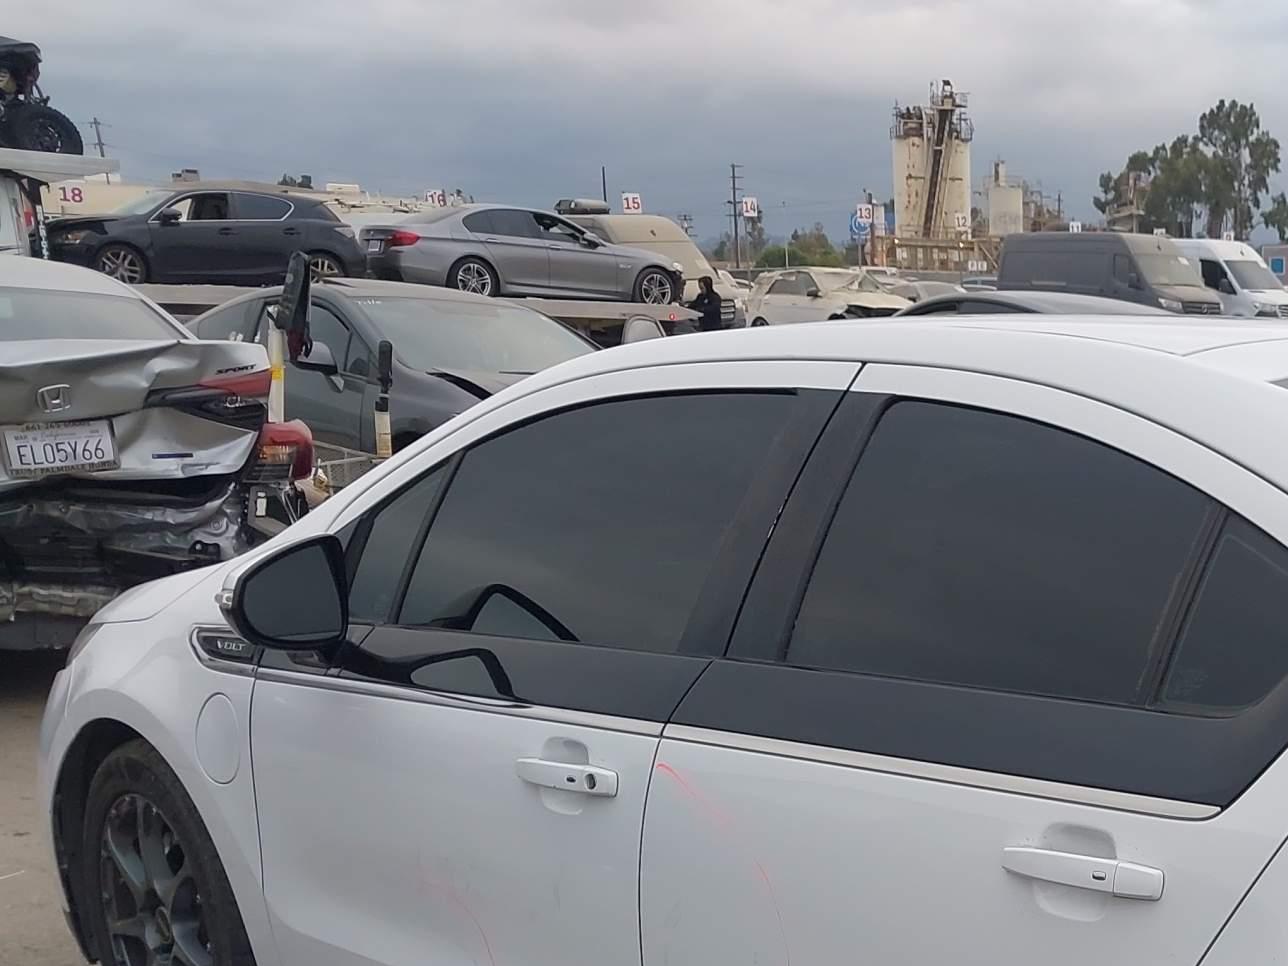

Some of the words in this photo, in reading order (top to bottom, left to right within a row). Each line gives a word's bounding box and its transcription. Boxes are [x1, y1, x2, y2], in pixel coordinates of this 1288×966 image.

[59, 186, 83, 203] 18
[623, 196, 640, 210] 15
[743, 201, 756, 213] 14
[858, 207, 872, 219] 13
[956, 216, 968, 227] 12
[216, 364, 257, 376] SPORT
[16, 438, 105, 467] EL05Y66
[40, 463, 85, 474] PALMDALE
[216, 640, 246, 651] VOLT
